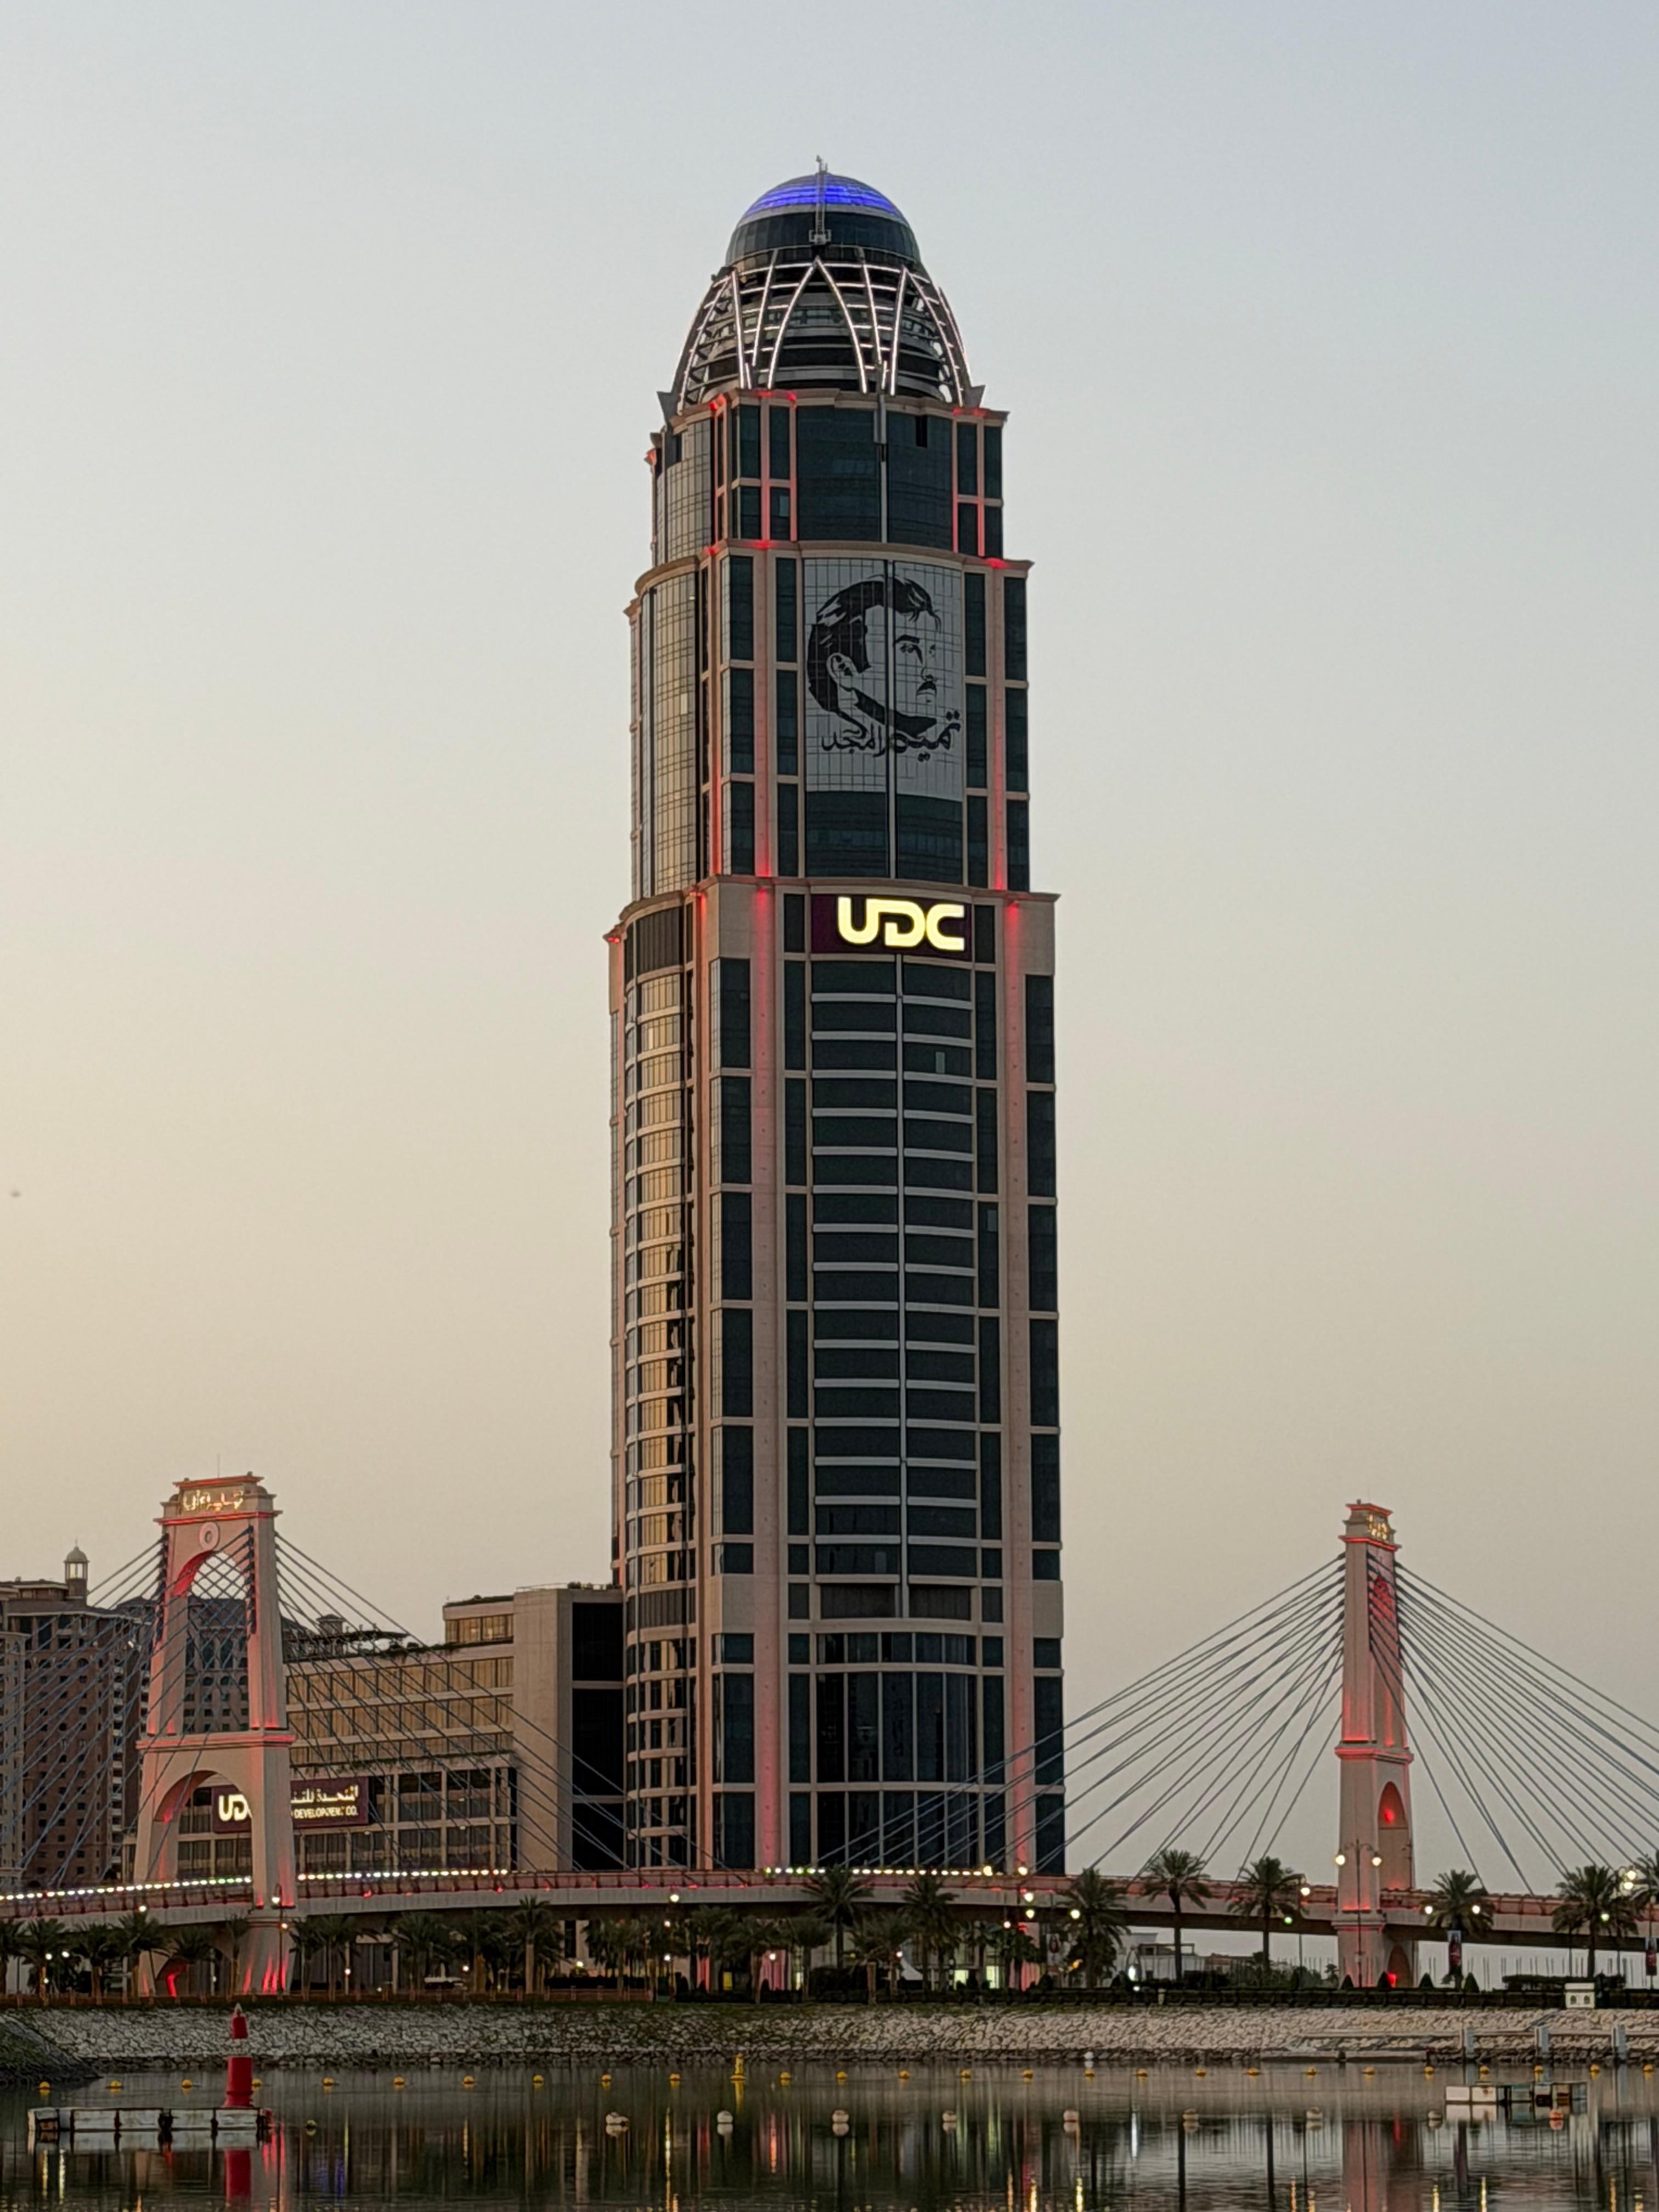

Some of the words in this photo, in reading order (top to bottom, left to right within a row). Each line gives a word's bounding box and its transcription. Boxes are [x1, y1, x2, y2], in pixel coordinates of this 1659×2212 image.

[821, 722, 882, 755] المجد
[872, 710, 961, 763] تميم
[837, 895, 965, 951] UDC
[218, 1794, 253, 1821] UD
